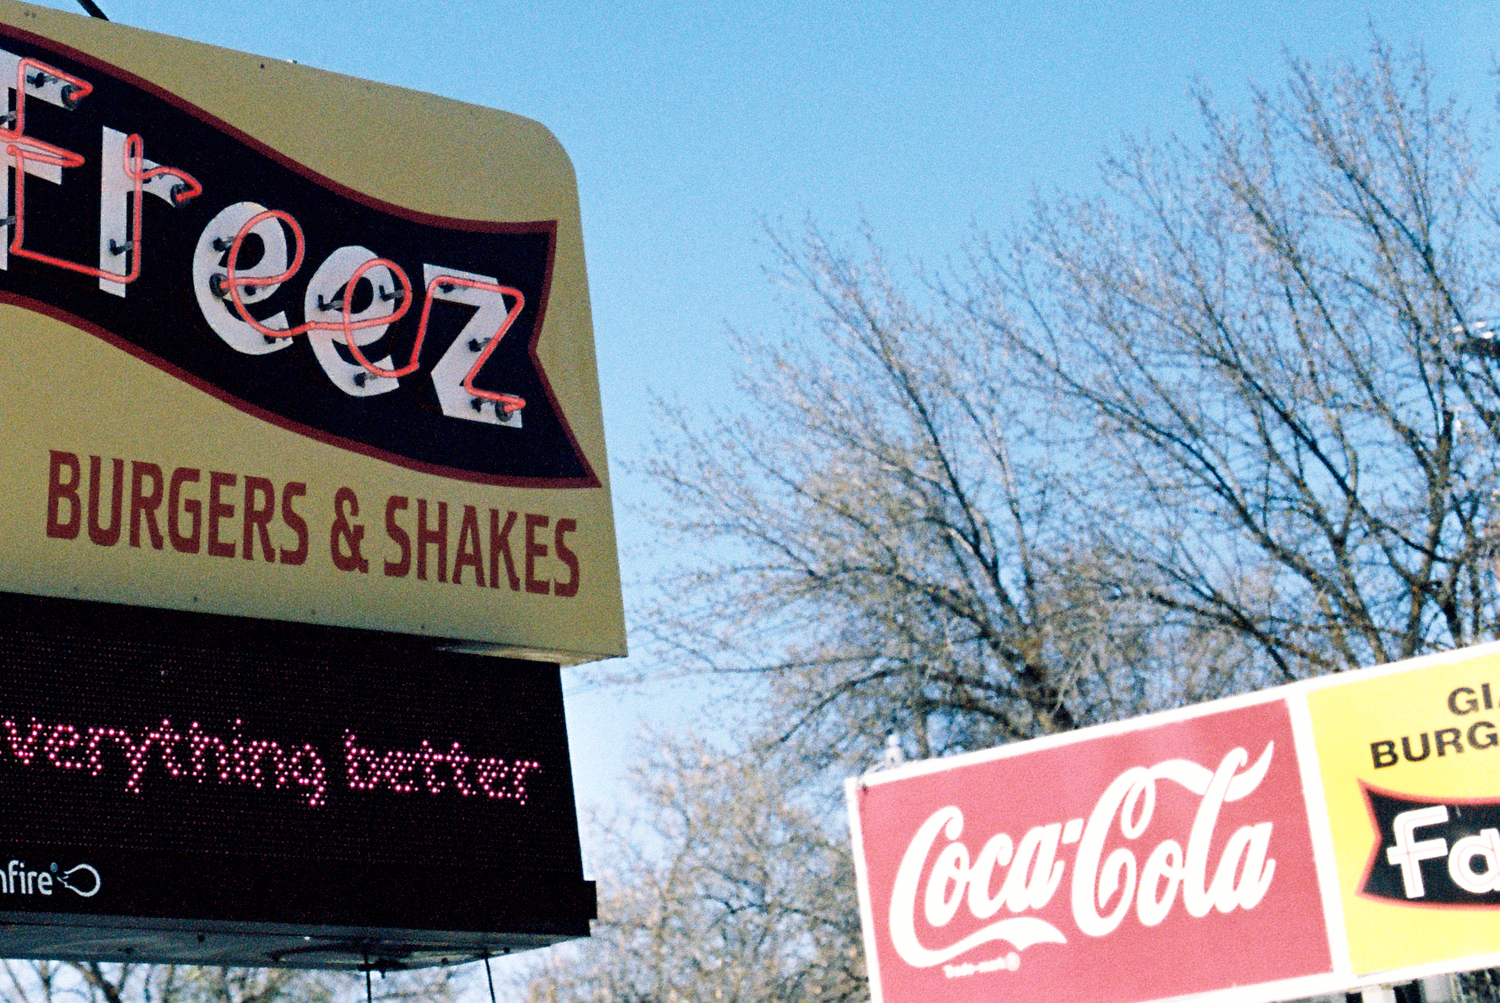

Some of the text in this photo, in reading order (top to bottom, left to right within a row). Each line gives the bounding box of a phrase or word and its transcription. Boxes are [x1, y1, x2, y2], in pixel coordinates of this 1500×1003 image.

[46, 449, 580, 597] BURGERS & SHAKES
[1447, 683, 1500, 716] GI
[342, 728, 542, 805] better
[889, 739, 1276, 968] Coca-Cola
